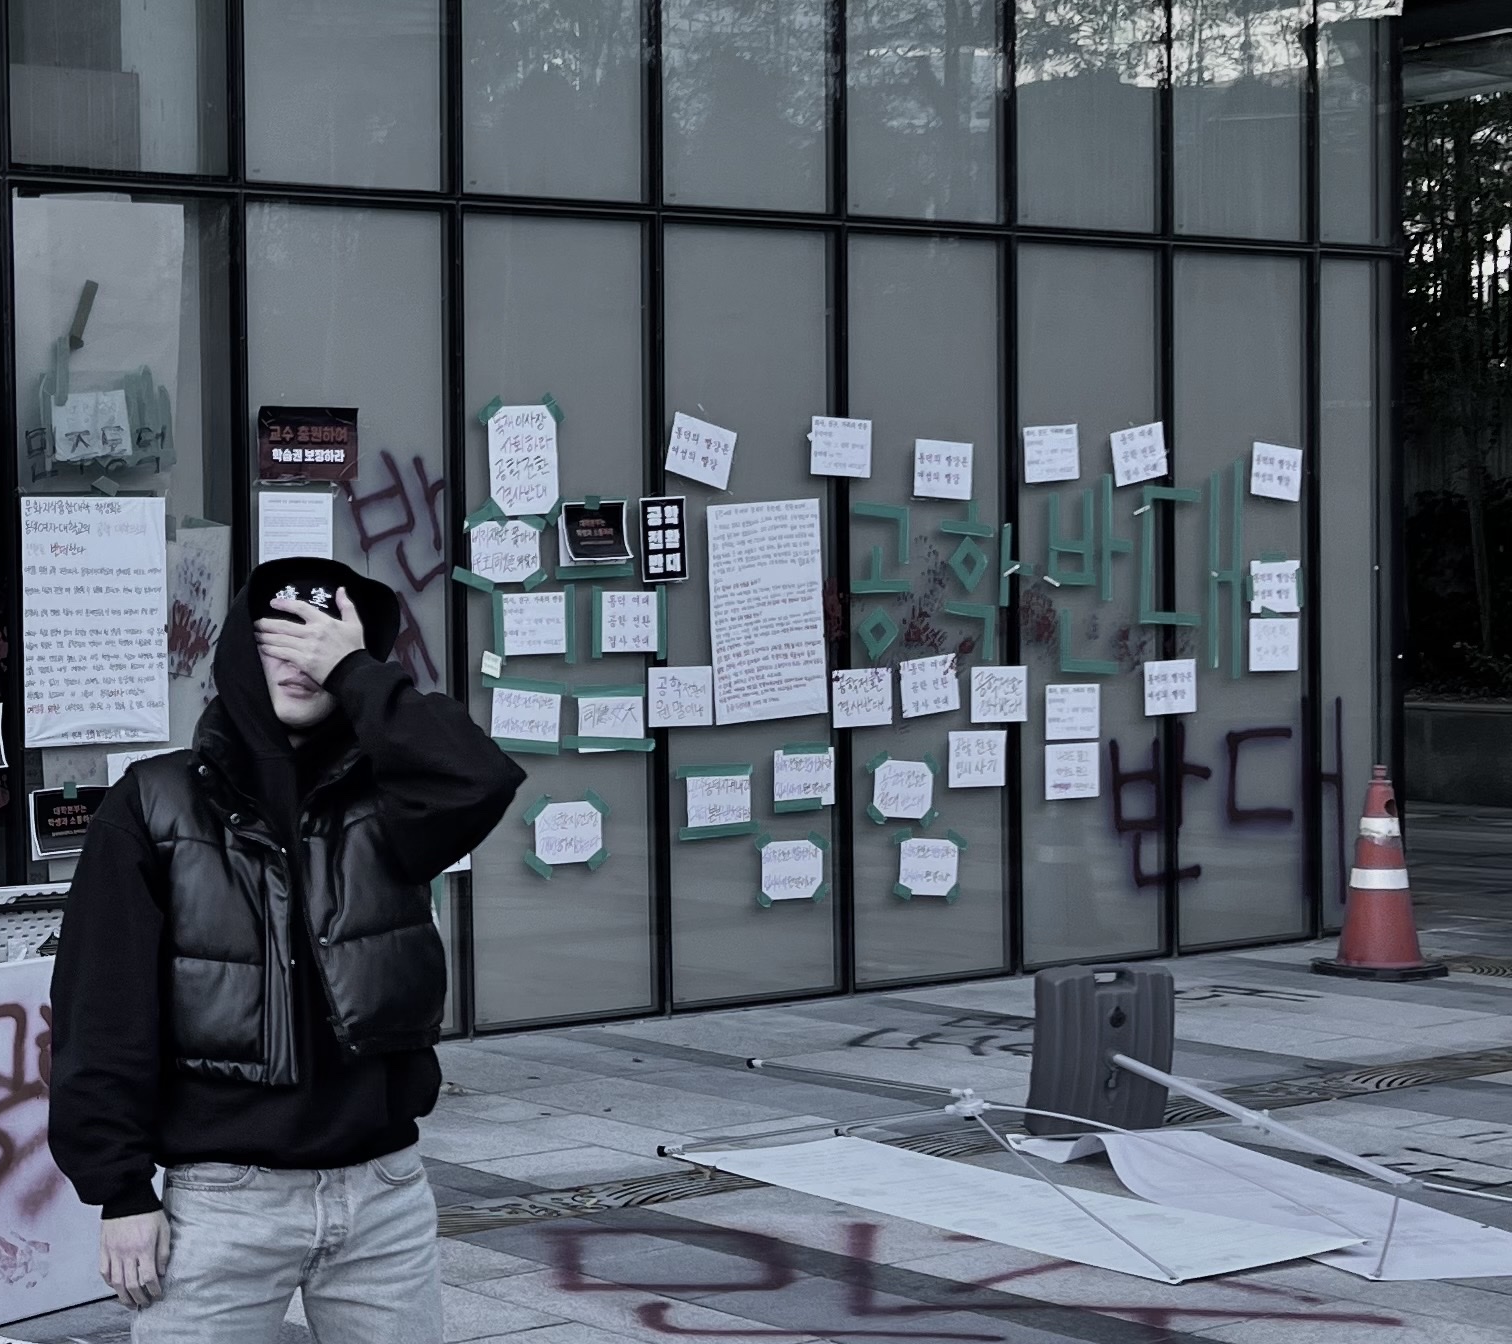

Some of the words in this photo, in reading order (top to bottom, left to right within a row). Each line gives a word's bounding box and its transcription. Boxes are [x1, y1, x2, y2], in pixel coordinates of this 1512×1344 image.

[269, 425, 294, 443] 교수
[296, 425, 348, 444] 충원하여
[271, 448, 303, 463] 학습권
[304, 447, 345, 463] 보장하라
